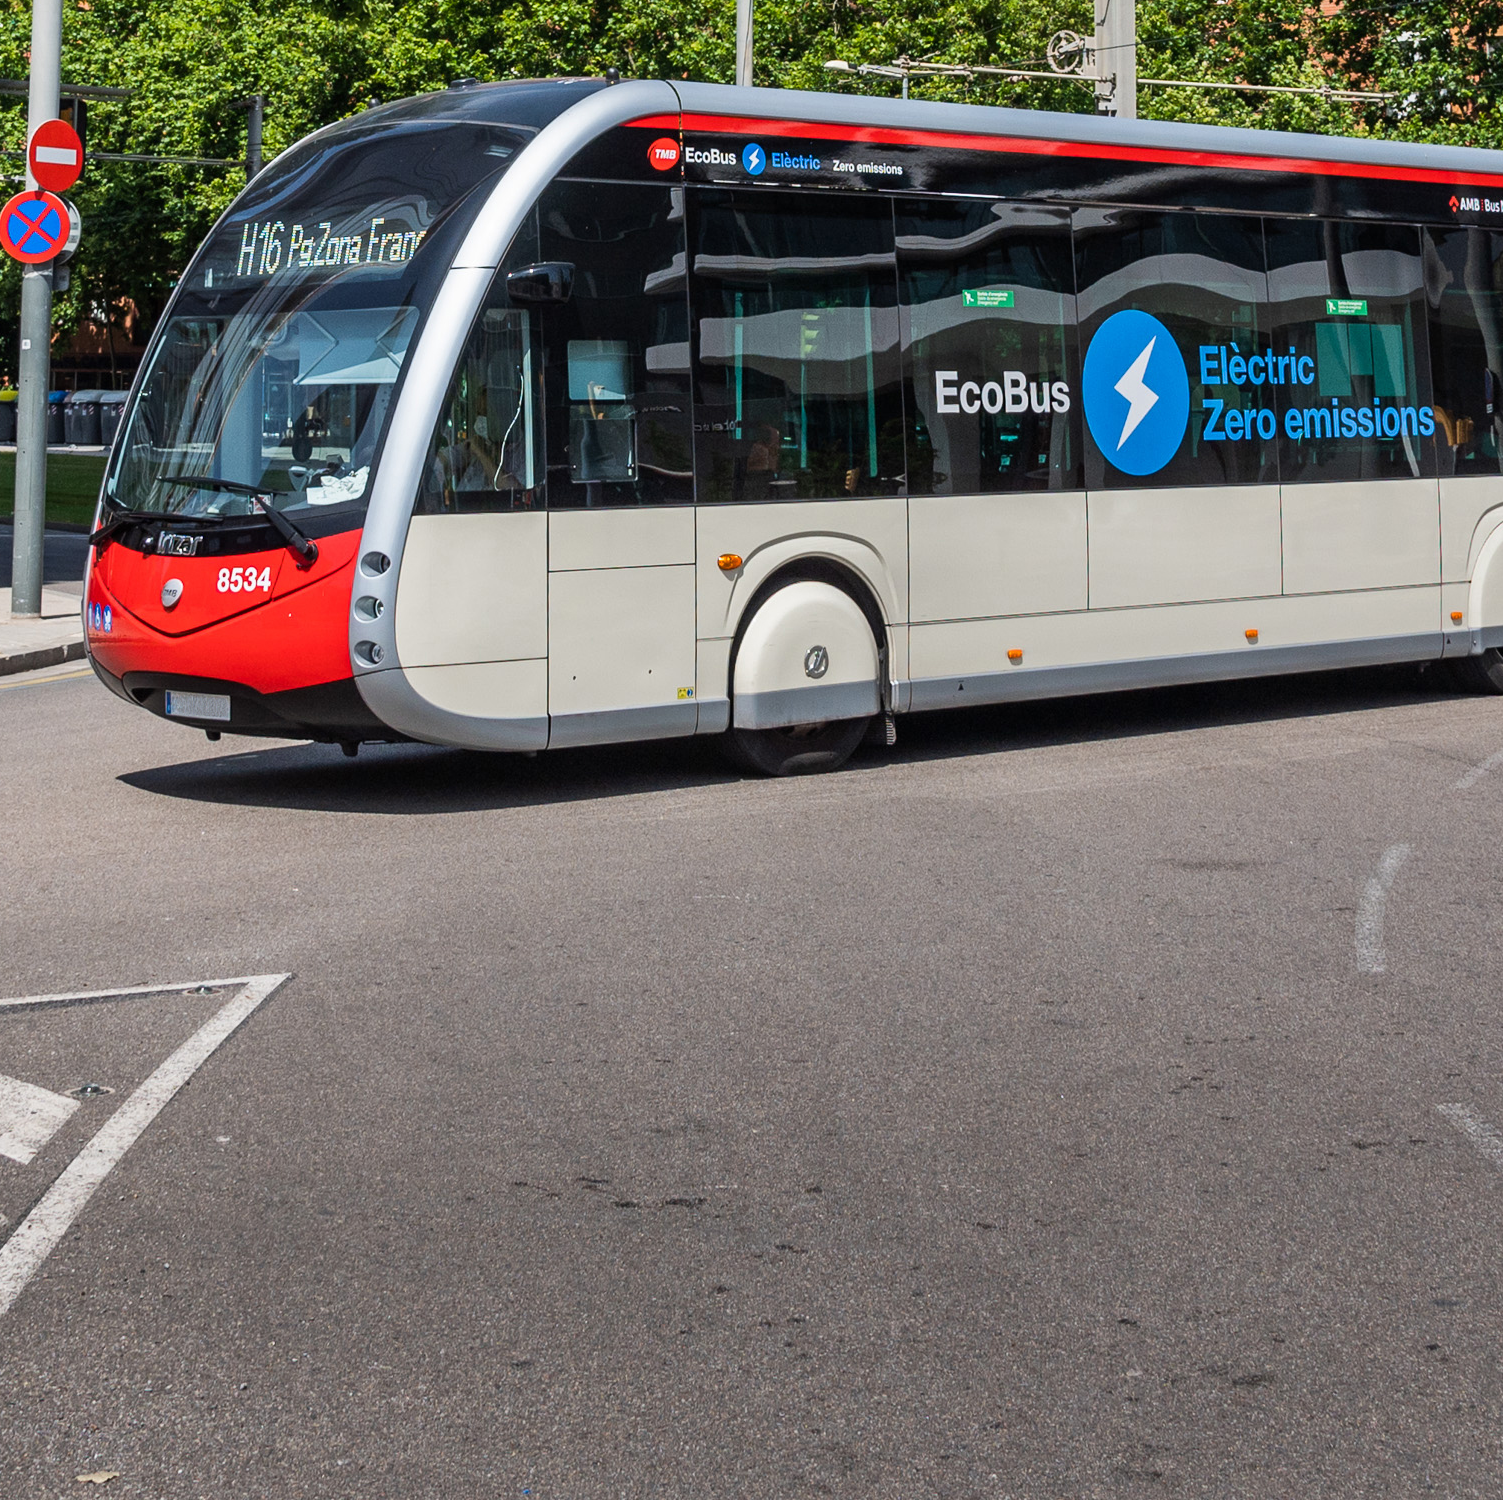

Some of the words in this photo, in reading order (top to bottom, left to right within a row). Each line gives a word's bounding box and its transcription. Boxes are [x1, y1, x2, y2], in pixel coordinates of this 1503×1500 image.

[655, 148, 677, 160] TMB
[685, 147, 737, 165] EcoBus
[771, 152, 821, 170] Elèctric
[832, 159, 855, 173] Zero
[856, 161, 903, 176] emissions
[1460, 197, 1480, 211] AMB
[1484, 198, 1500, 213] Bus
[237, 221, 285, 276] H16
[1199, 342, 1315, 386] Elèctric
[935, 370, 1070, 415] EcoBus
[1203, 399, 1277, 441] Zero
[1284, 397, 1435, 440] emissions
[217, 566, 271, 593] 8534
